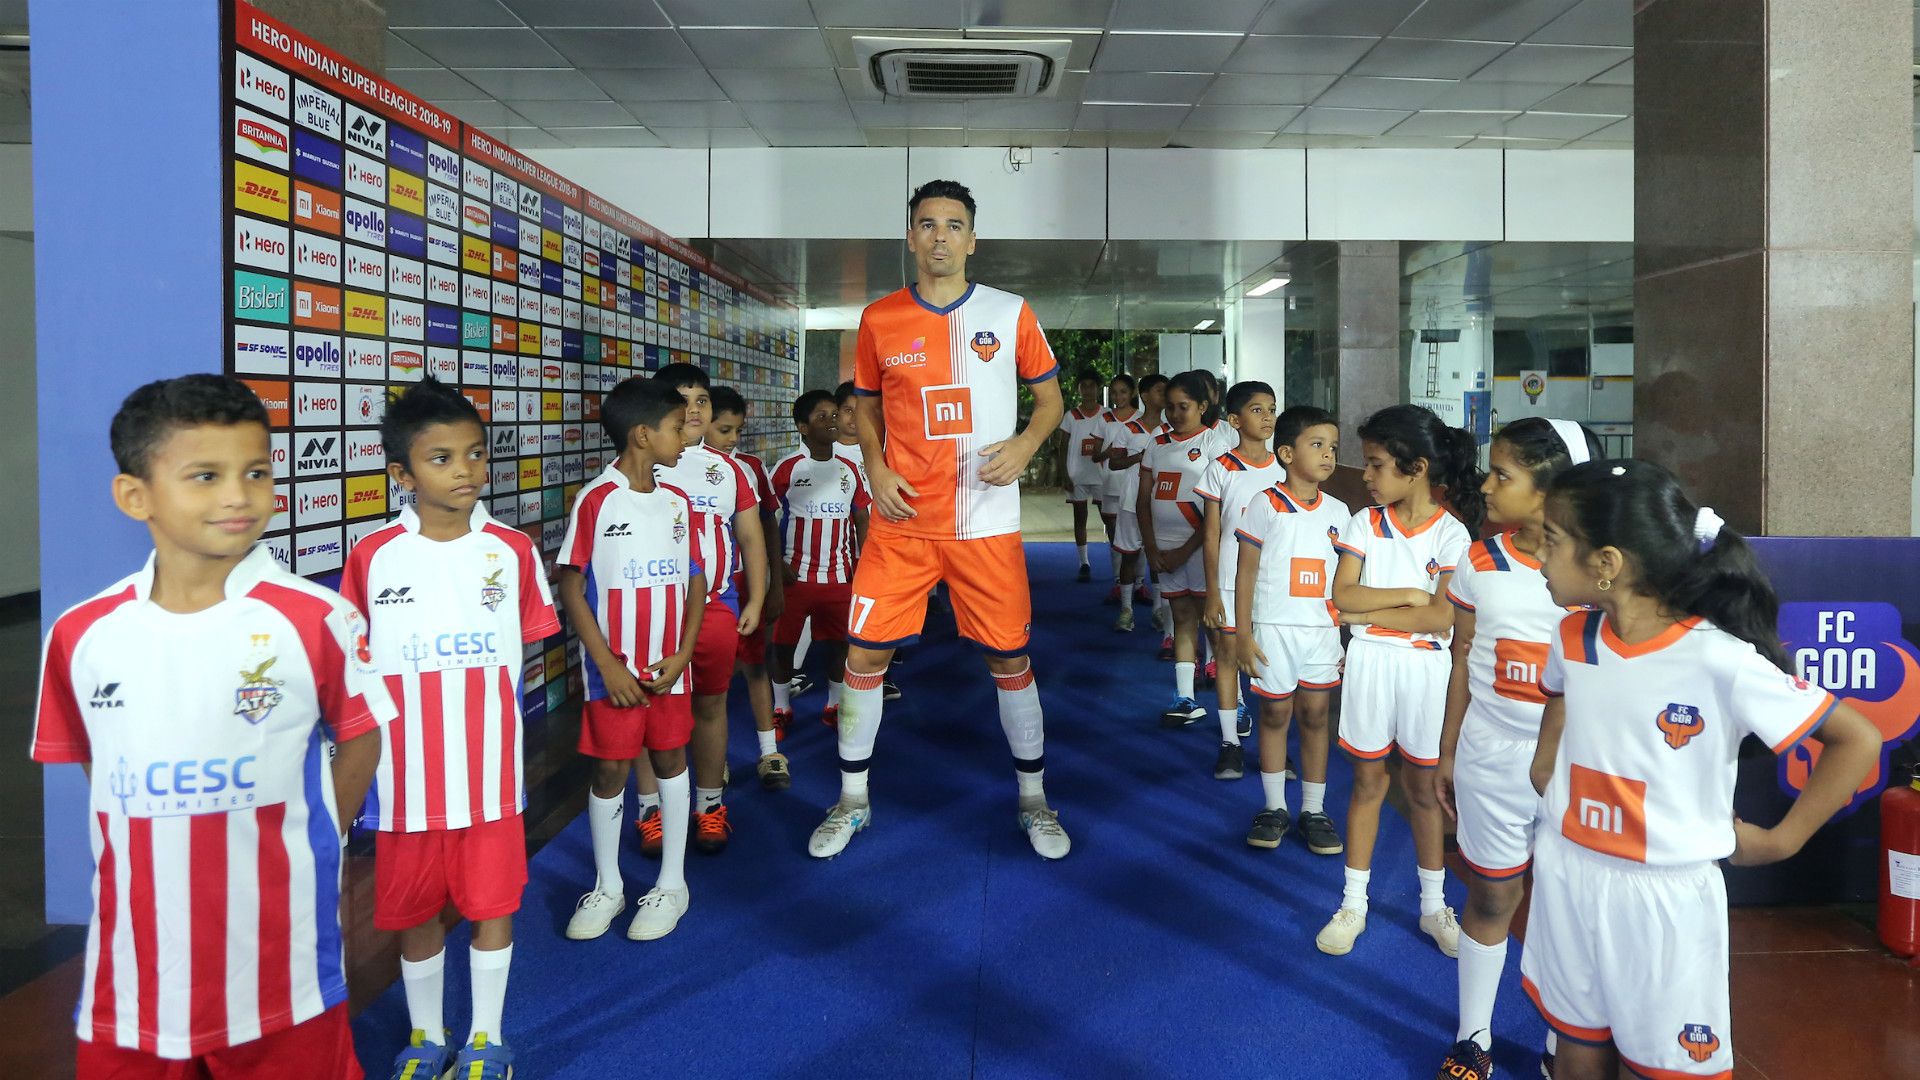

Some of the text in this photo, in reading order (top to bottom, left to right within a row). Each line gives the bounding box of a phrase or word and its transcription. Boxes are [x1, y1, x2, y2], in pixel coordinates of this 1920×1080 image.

[252, 18, 451, 134] HERO INDIAN SUPER LEAGUE 2018-19
[255, 77, 286, 101] Hero
[296, 94, 340, 126] IMPERIAL
[307, 112, 330, 132] BLUE
[242, 123, 284, 148] BRITANNIA
[348, 130, 384, 153] NIVIA
[471, 133, 492, 154] HERO
[493, 144, 516, 168] INDIAN
[517, 158, 536, 178] SUPER
[428, 153, 458, 176] apollo
[360, 170, 382, 188] Hero
[473, 174, 489, 189] Hero
[245, 181, 280, 203] DHL
[395, 183, 419, 200] DHL
[315, 203, 340, 219] Xiaomi
[428, 193, 458, 217] IMPERIAL
[520, 205, 540, 218] NIVIA
[346, 210, 384, 232] apollo
[436, 207, 451, 221] BLUE
[255, 237, 285, 256] Hero
[311, 250, 337, 267] Hero
[467, 249, 487, 262] DHL
[359, 261, 382, 277] Hero
[520, 261, 540, 279] apollo
[401, 271, 421, 285] Hero
[439, 279, 456, 293] Hero
[239, 285, 285, 310] Bisleri
[472, 287, 488, 299] Hero
[501, 295, 515, 305] Hero
[315, 301, 340, 315] Xiaomi
[352, 306, 379, 319] DHL
[401, 315, 421, 327] Hero
[464, 322, 488, 338] Bisleri
[248, 343, 287, 355] SF SONIC
[296, 341, 340, 367] apollo
[359, 353, 382, 366] Hero
[439, 360, 456, 371] Hero
[885, 351, 927, 367] colors
[319, 363, 340, 372] TYRES
[493, 360, 516, 379] apollo
[312, 398, 337, 410] Hero
[501, 401, 515, 410] Hero
[272, 449, 285, 462] ro
[360, 444, 383, 456] Hero
[494, 445, 516, 453] NIVIA
[298, 458, 338, 470] NIVIA
[312, 493, 338, 509] Hero
[354, 489, 380, 502] DHL
[689, 495, 719, 507] ESC
[307, 542, 340, 555] SF SONIC
[374, 597, 415, 606] NIVIA
[848, 593, 876, 634] 17
[1818, 610, 1855, 643] FC
[435, 632, 496, 657] CESC
[1795, 647, 1876, 690] GOA
[1670, 711, 1693, 725] GOA
[1678, 705, 1688, 715] FC
[146, 755, 257, 796] CESC
[147, 793, 255, 811] LIMITED
[1690, 1032, 1707, 1043] GOA
